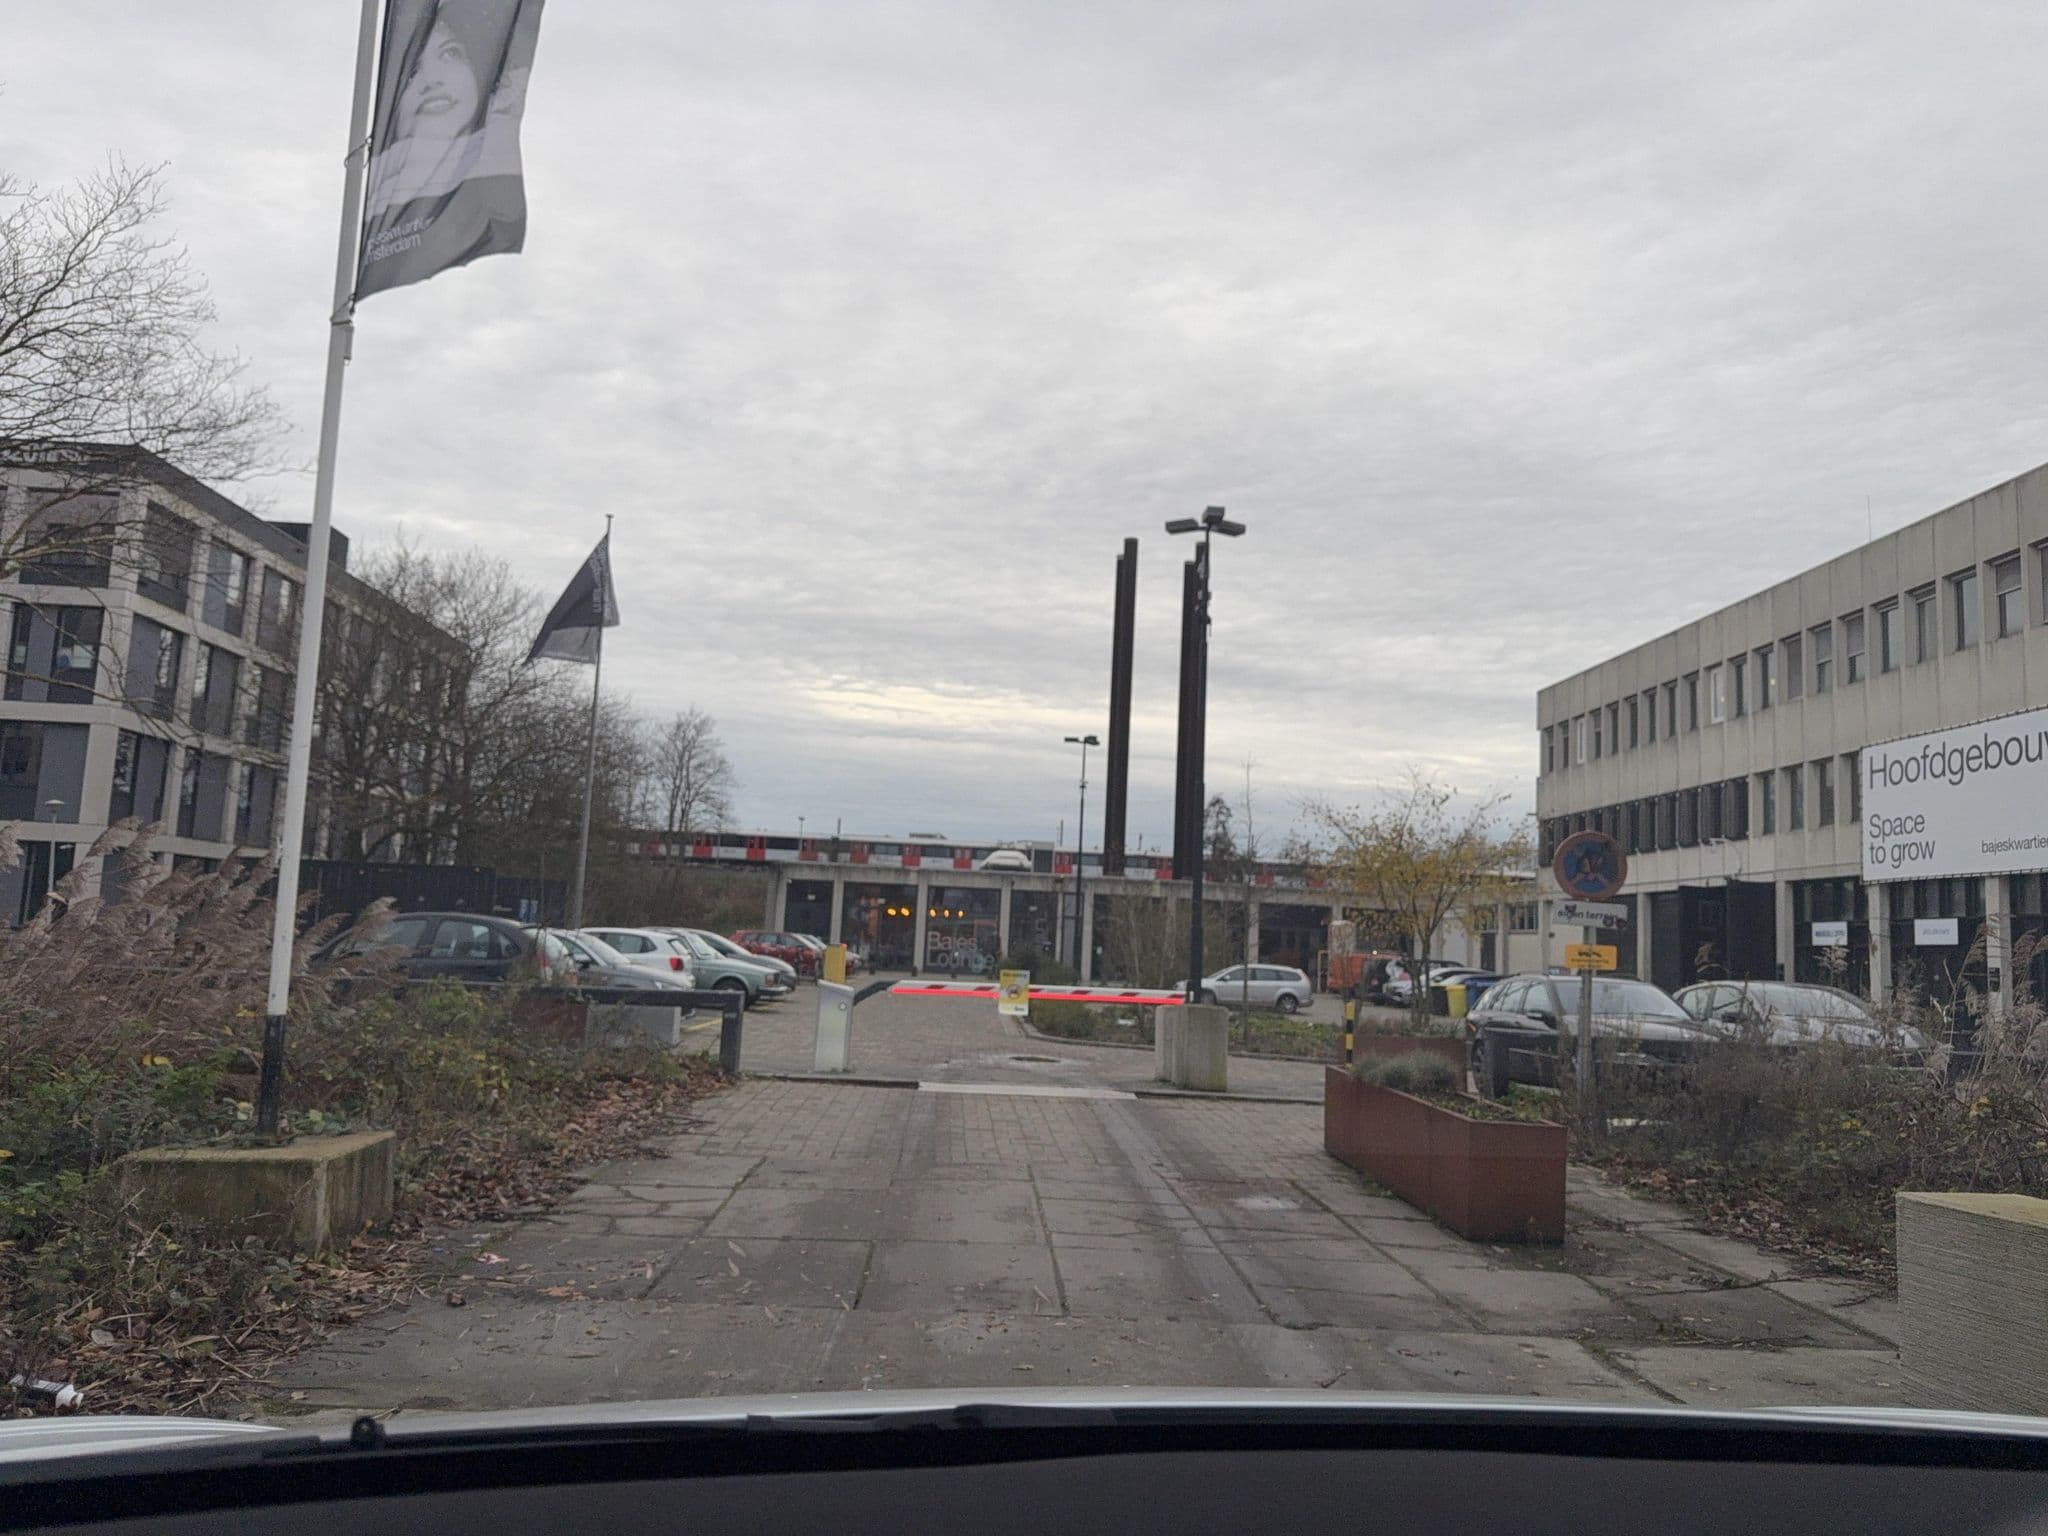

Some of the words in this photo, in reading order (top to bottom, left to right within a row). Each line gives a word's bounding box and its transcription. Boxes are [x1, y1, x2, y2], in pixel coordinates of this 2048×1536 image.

[1869, 813, 1926, 843] Space
[1869, 842, 1887, 865] to
[1890, 840, 1936, 869] grow
